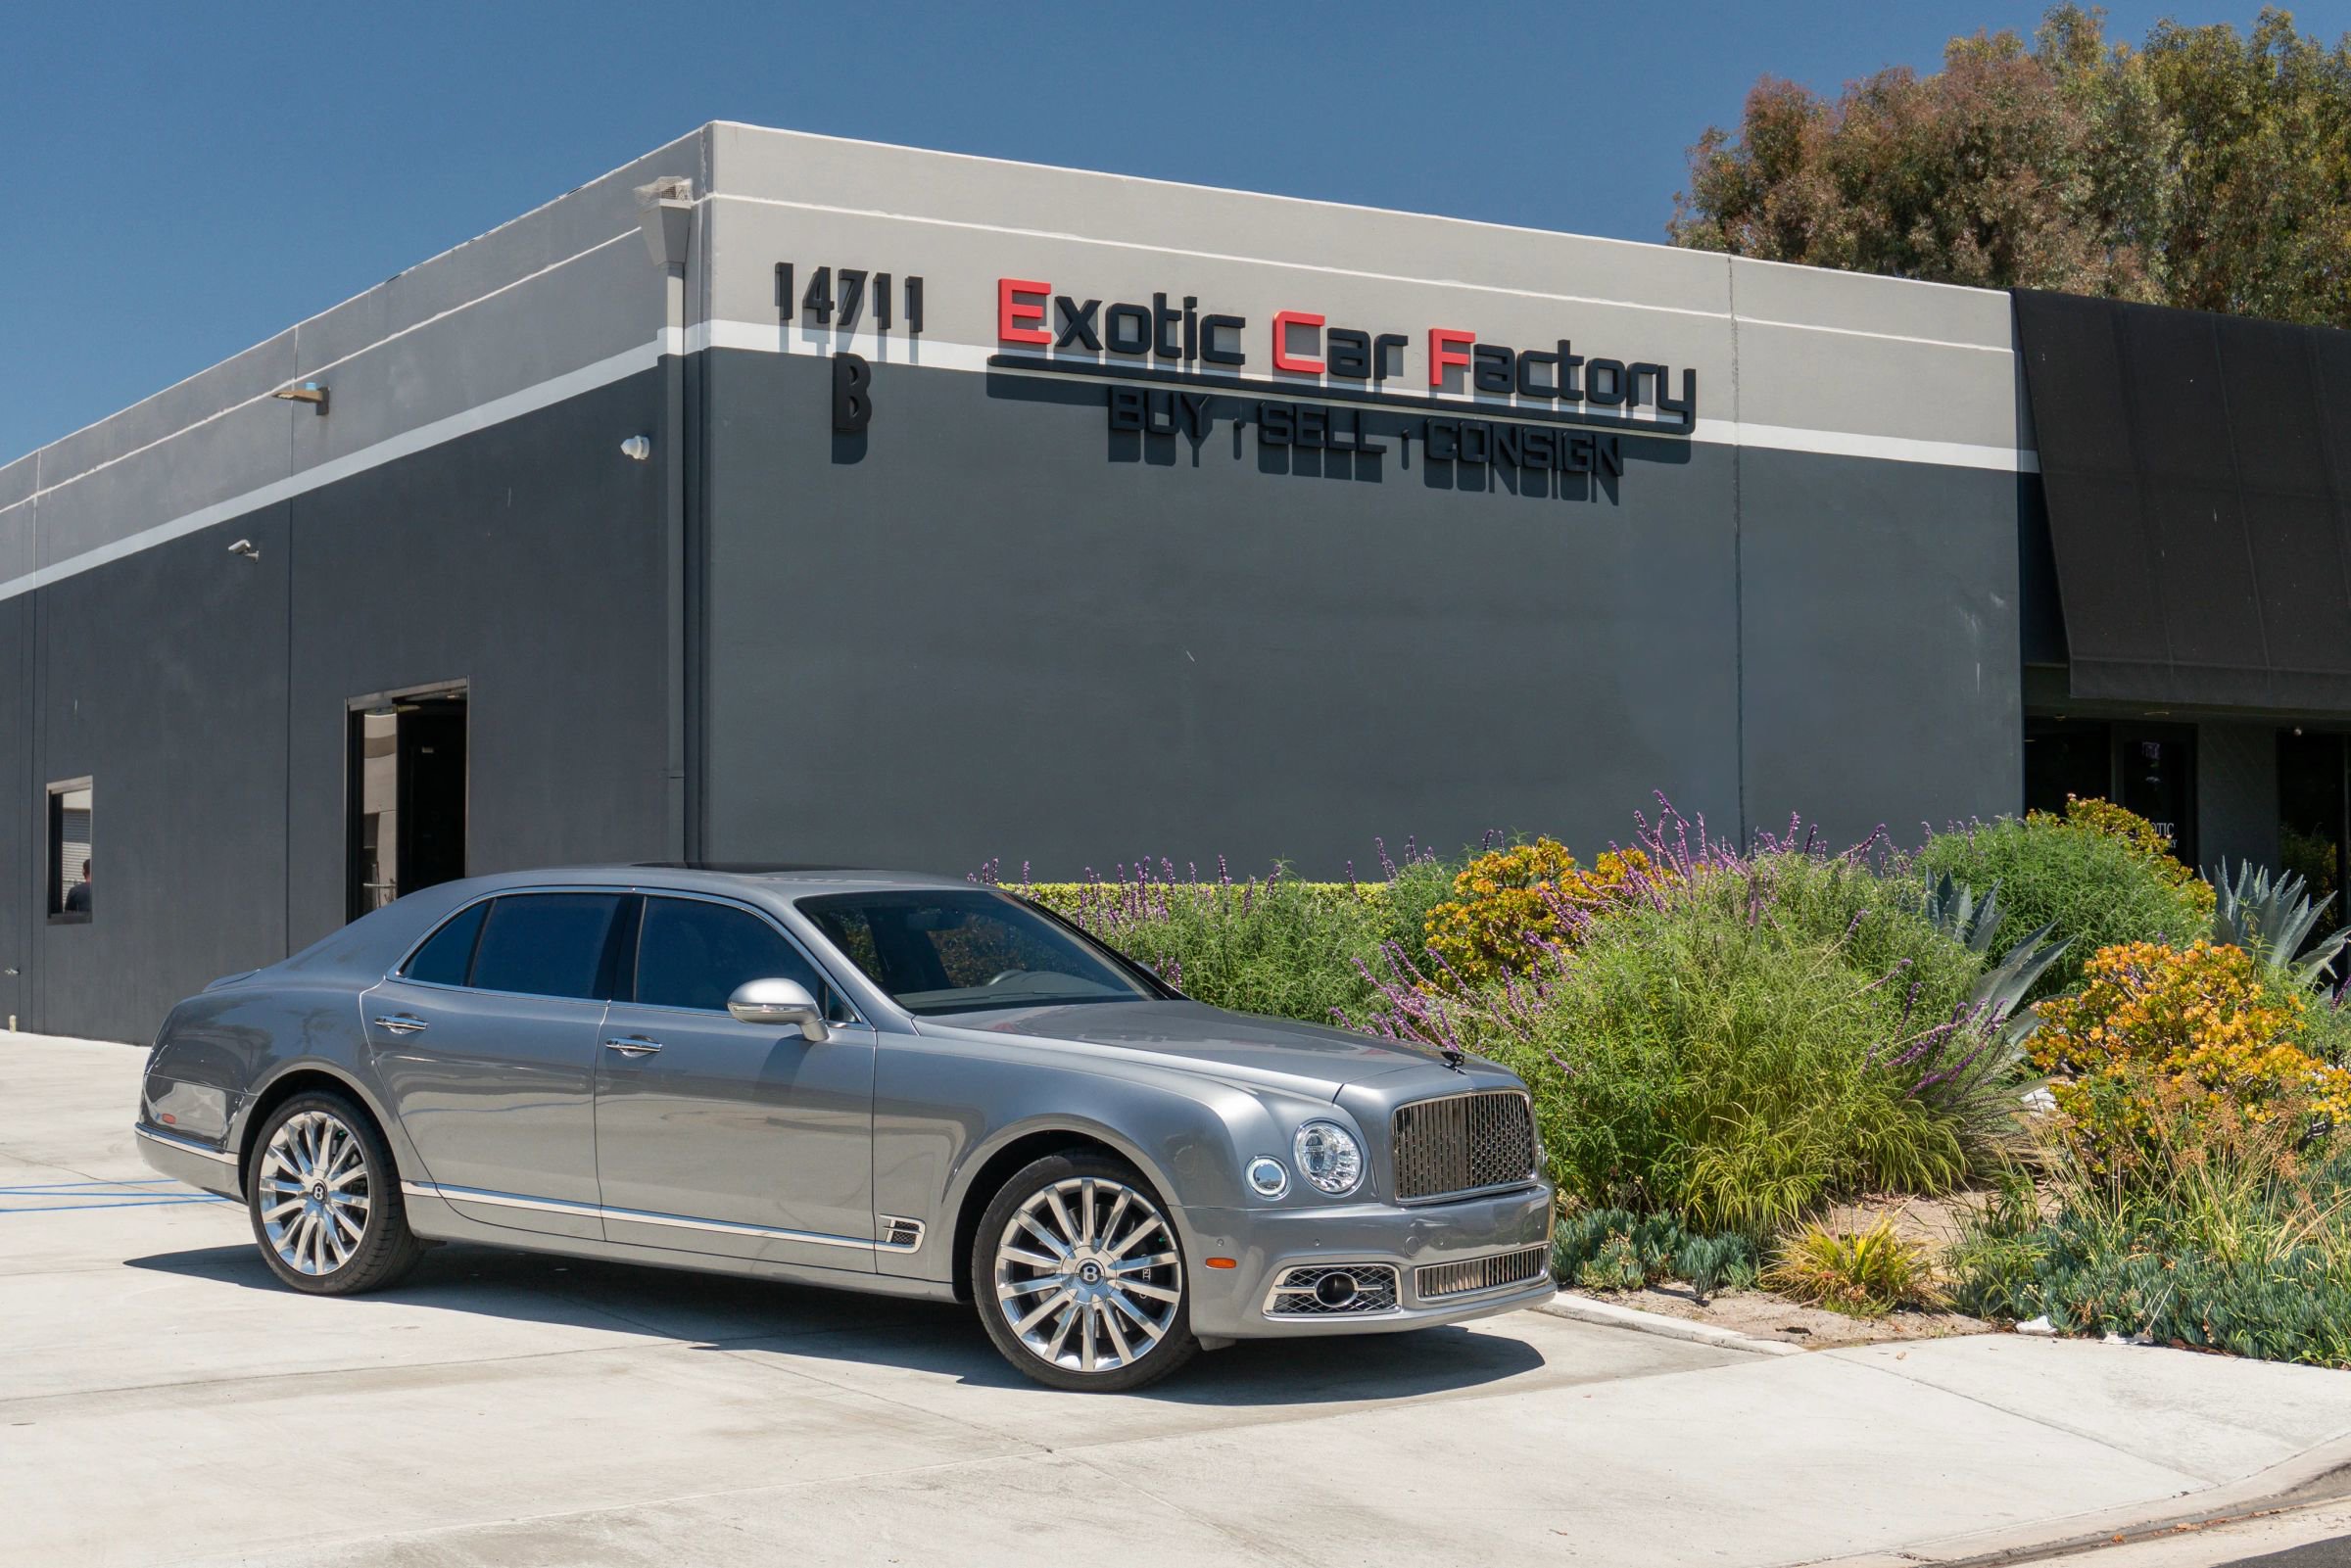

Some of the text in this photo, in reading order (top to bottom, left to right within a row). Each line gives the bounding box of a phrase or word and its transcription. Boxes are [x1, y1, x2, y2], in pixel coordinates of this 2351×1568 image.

[775, 261, 924, 333] 14711
[833, 353, 873, 432] B
[997, 278, 1697, 435] Exotic Car Factory
[1108, 386, 1624, 477] BUY SELL CONSIGN
